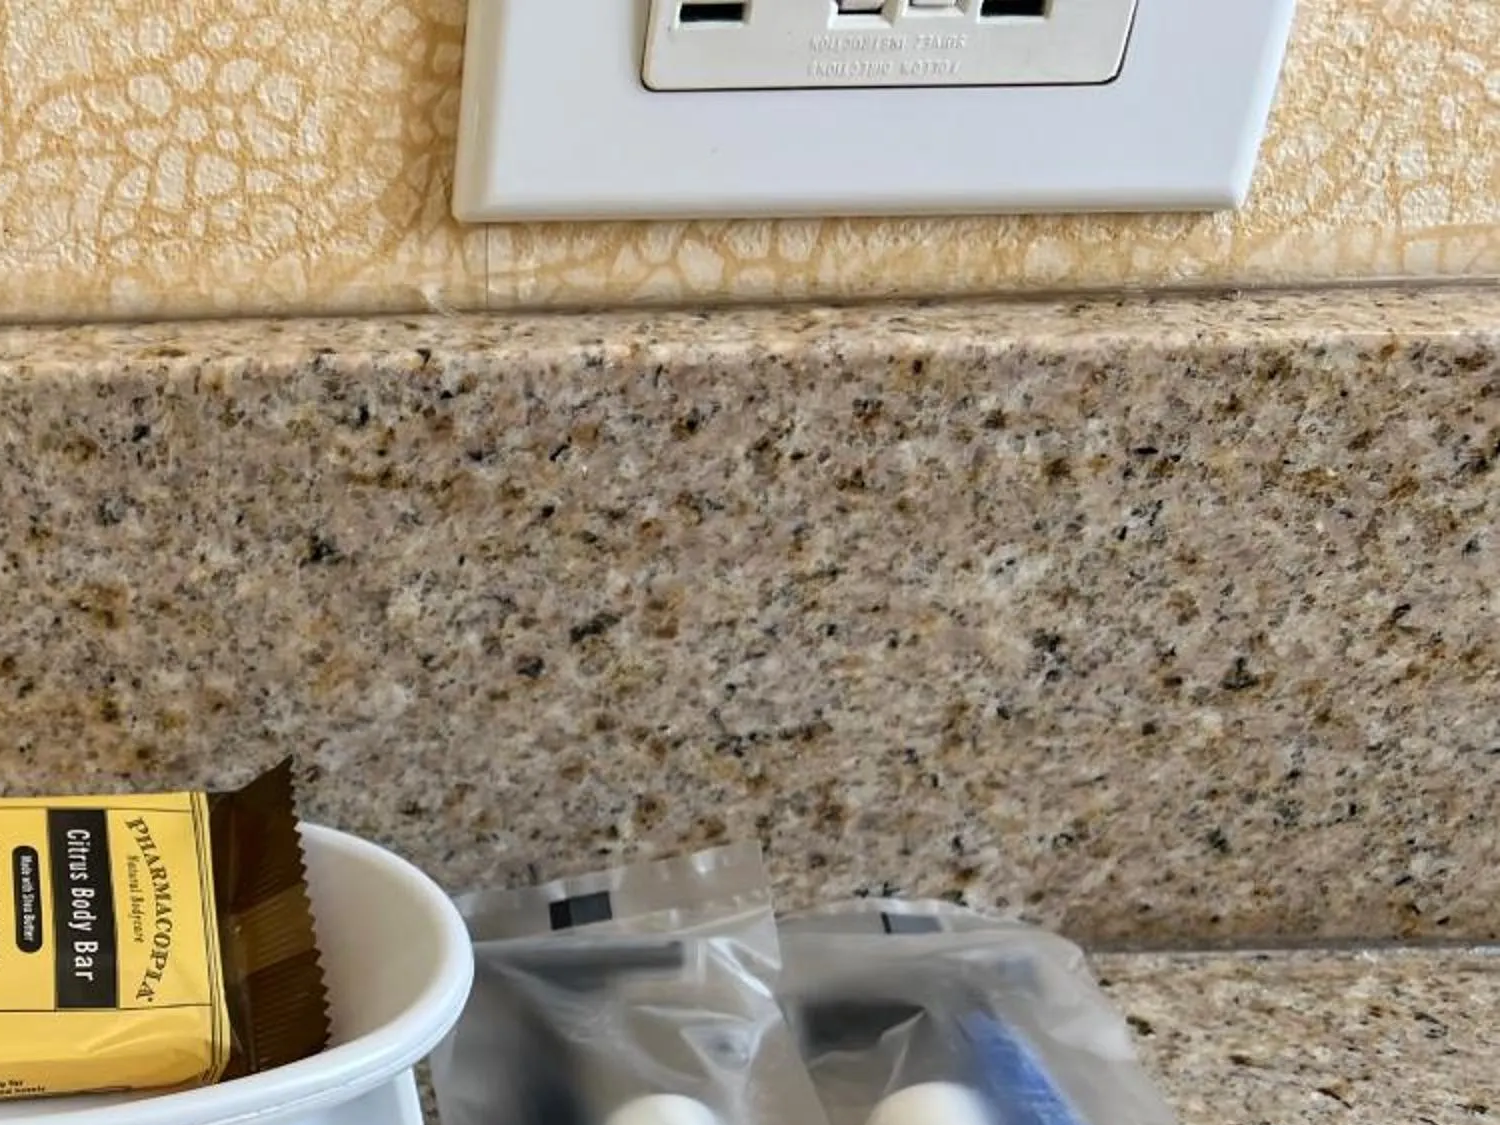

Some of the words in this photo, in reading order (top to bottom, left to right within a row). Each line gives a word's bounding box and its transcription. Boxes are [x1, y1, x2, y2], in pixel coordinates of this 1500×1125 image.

[20, 855, 33, 875] Made
[66, 829, 91, 881] Citrus
[127, 854, 142, 893] Natural
[22, 877, 35, 893] with
[22, 894, 34, 913] Shea
[23, 913, 36, 941] Butter
[68, 887, 97, 931] Body
[125, 816, 173, 1002] PHARMACOPIA
[128, 895, 145, 943] Bodycare
[73, 940, 99, 981] Bar
